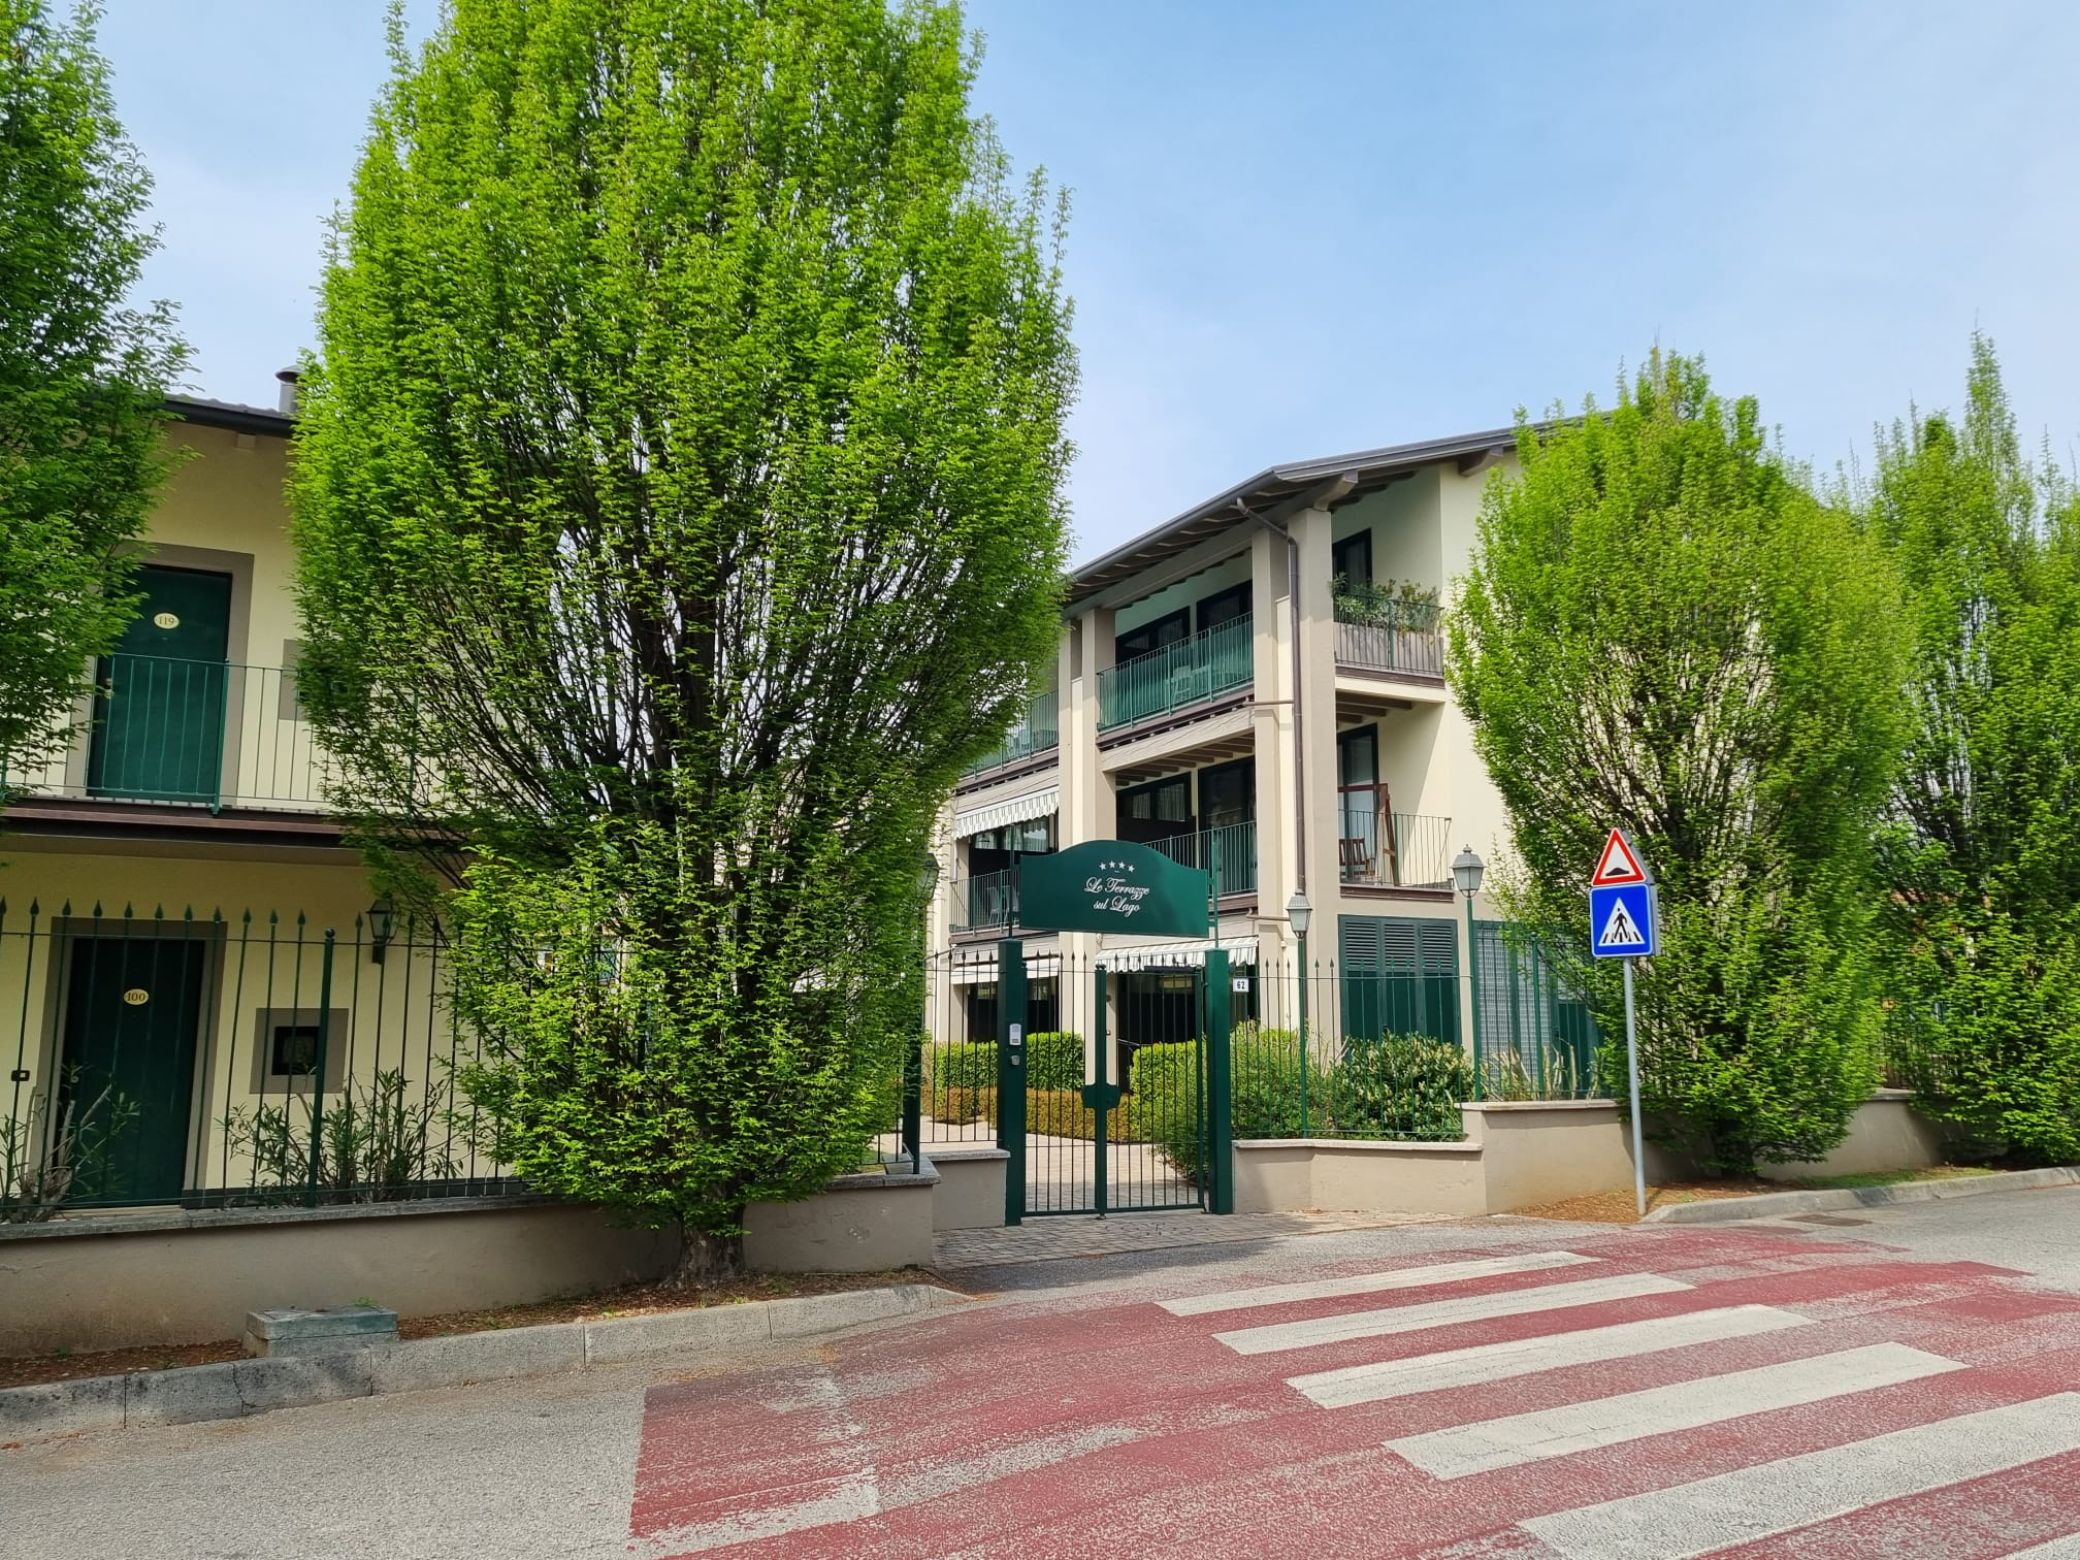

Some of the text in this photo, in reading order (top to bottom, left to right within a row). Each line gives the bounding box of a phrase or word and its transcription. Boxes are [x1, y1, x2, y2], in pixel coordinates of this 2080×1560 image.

[158, 615, 176, 626] 119
[1083, 876, 1150, 900] Le Terrazze
[1093, 895, 1141, 917] sul Lago
[127, 991, 146, 1002] 100
